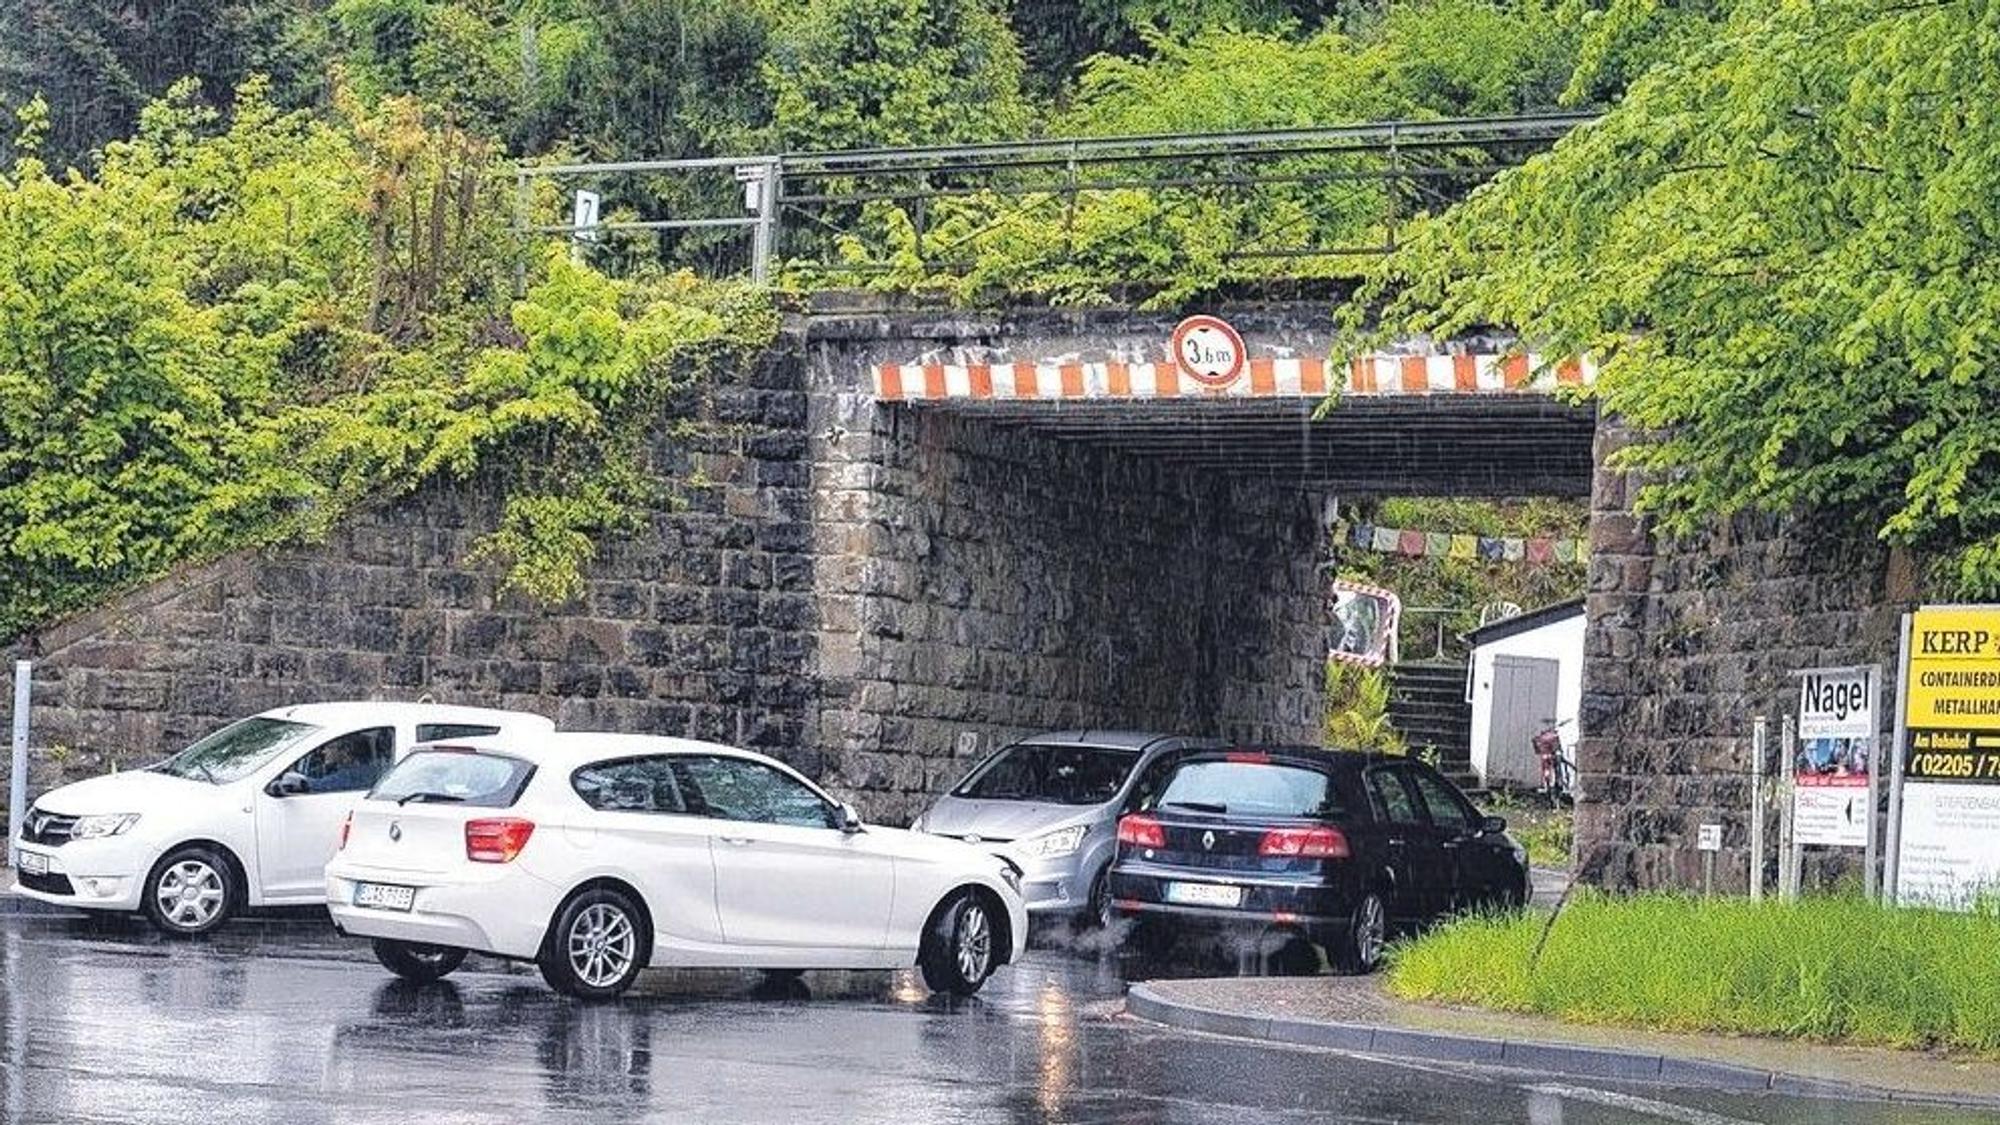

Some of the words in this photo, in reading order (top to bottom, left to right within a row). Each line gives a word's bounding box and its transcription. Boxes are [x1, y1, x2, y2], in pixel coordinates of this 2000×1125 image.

[1922, 631, 1989, 654] KERP
[1804, 671, 1870, 721] Nagel
[1922, 753, 1974, 776] 02205
[1987, 755, 2000, 777] 7
